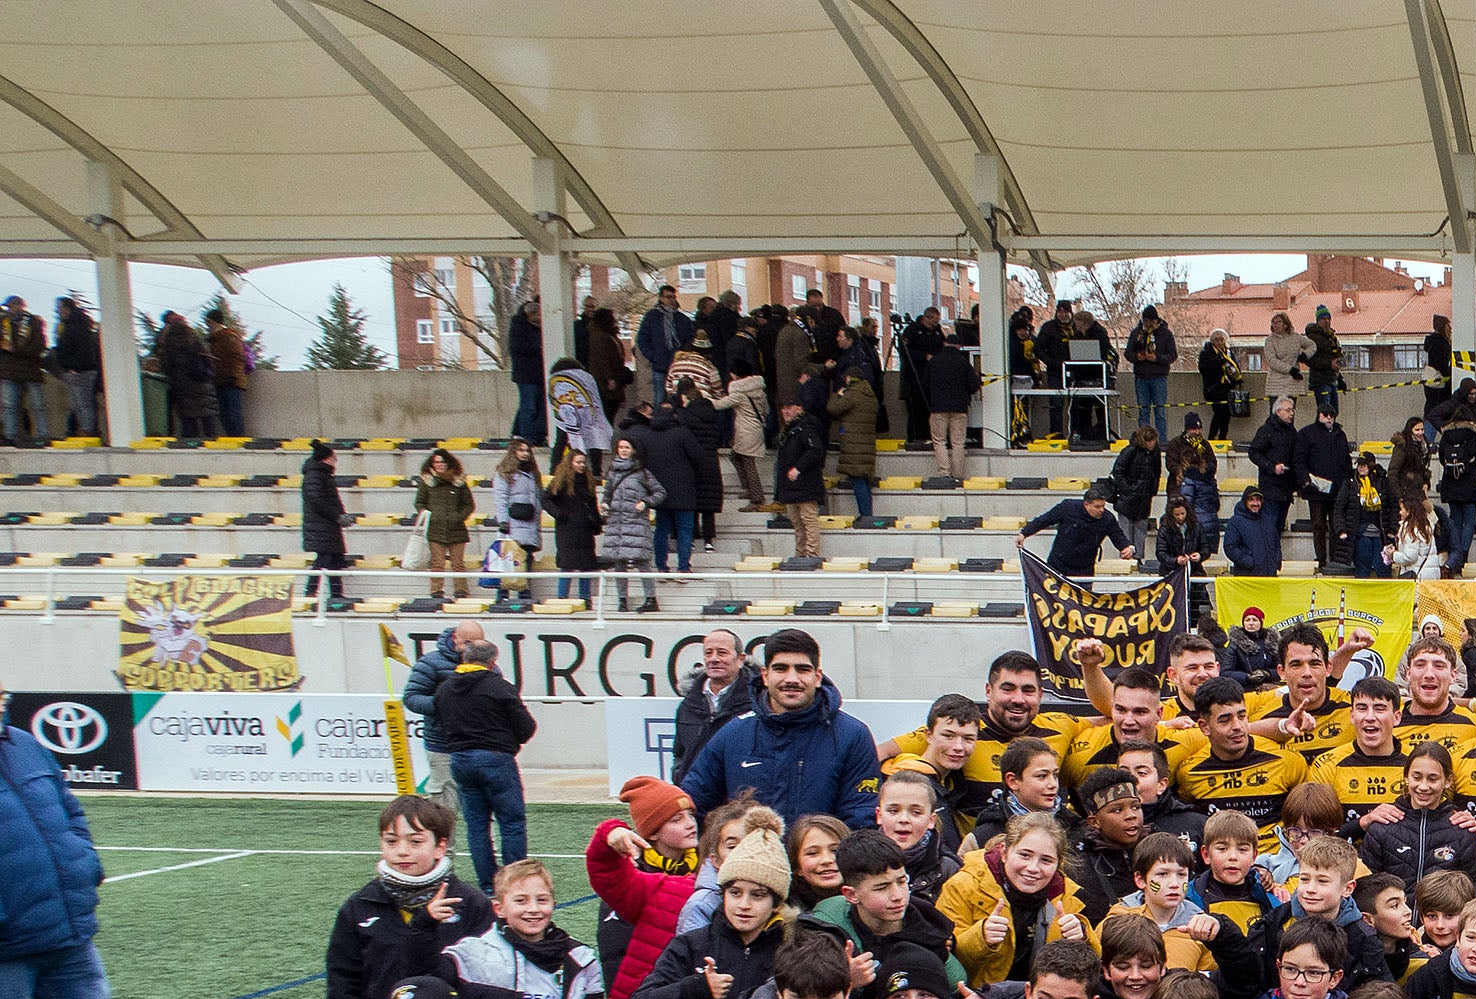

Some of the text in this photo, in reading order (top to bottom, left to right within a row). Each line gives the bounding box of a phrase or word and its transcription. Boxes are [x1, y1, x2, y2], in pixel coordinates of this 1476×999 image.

[1347, 609, 1384, 626] BURGOS
[150, 710, 266, 742] cajaviva
[206, 743, 268, 756] cajarural
[318, 743, 391, 759] Fundació
[191, 768, 397, 784] Valores por encima del Valo
[1367, 784, 1387, 795] nb
